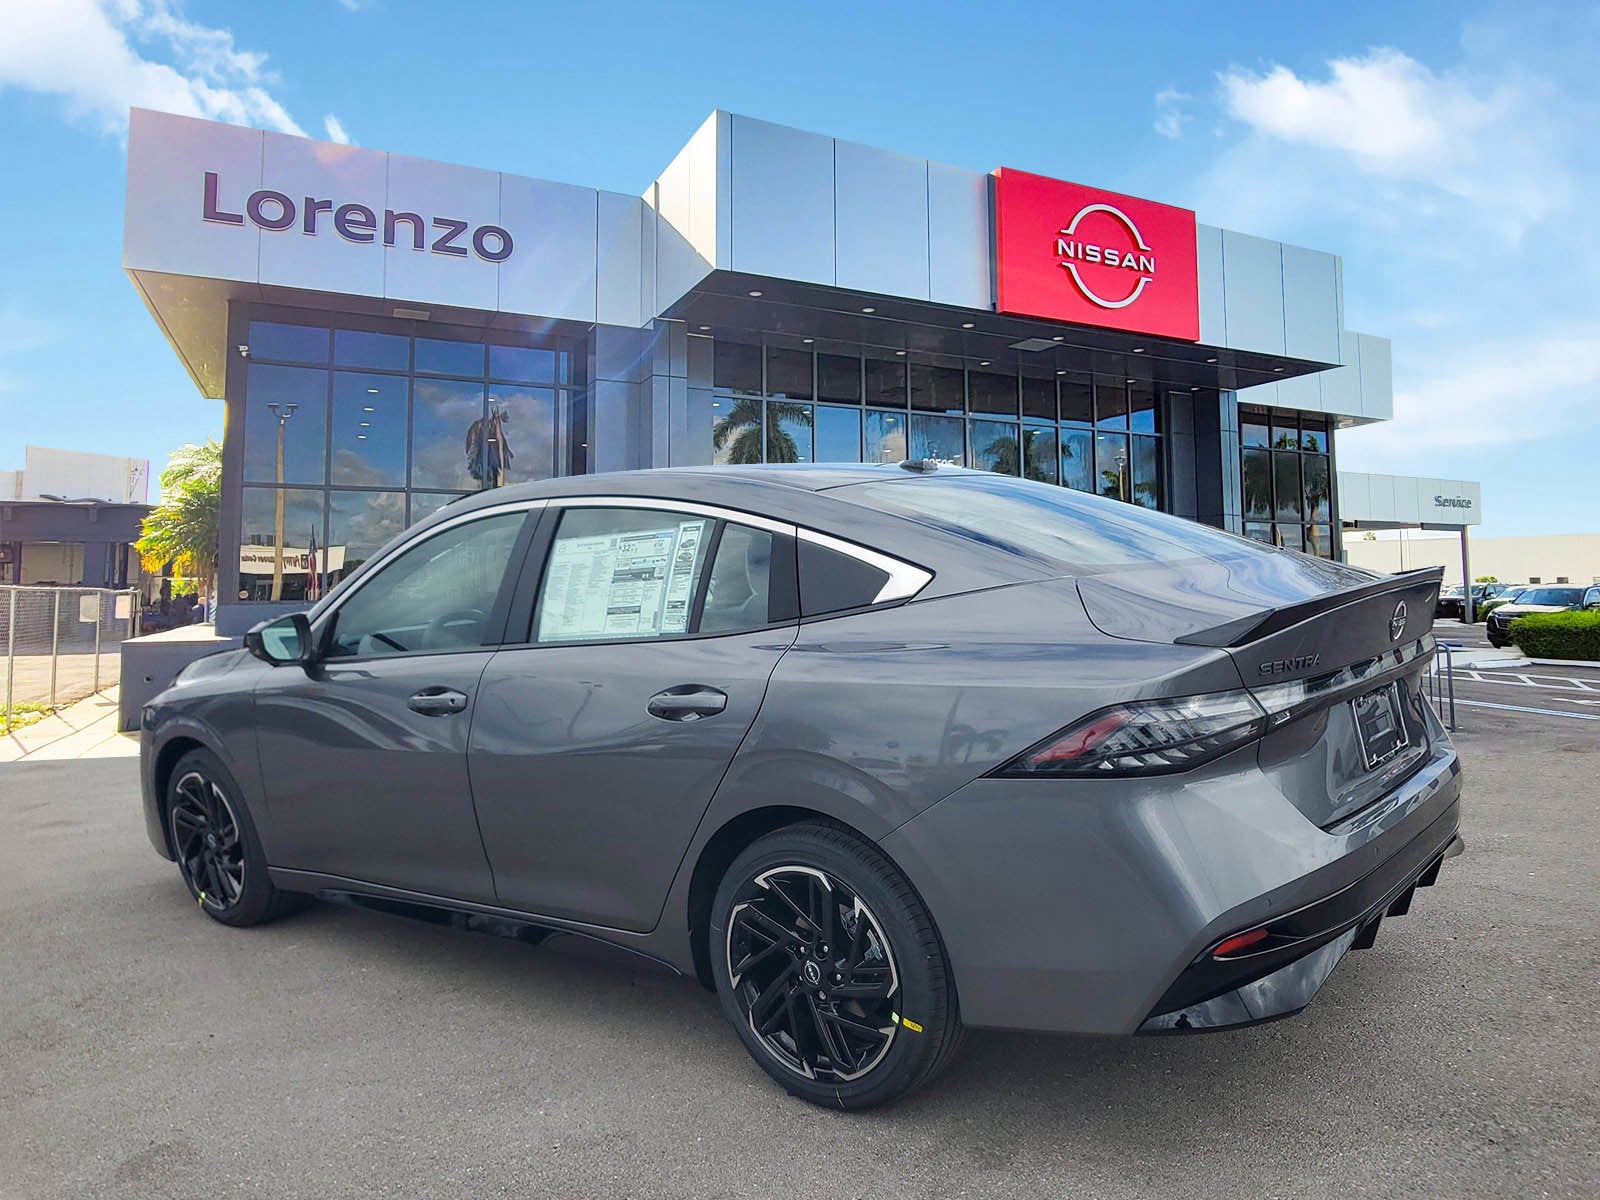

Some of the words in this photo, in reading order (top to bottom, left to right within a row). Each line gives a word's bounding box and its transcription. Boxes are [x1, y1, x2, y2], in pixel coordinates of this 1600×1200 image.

[202, 171, 514, 263] Lorenzo
[1057, 238, 1155, 273] NISSAN
[1434, 495, 1472, 508] Service
[1258, 653, 1321, 676] SENTRA
